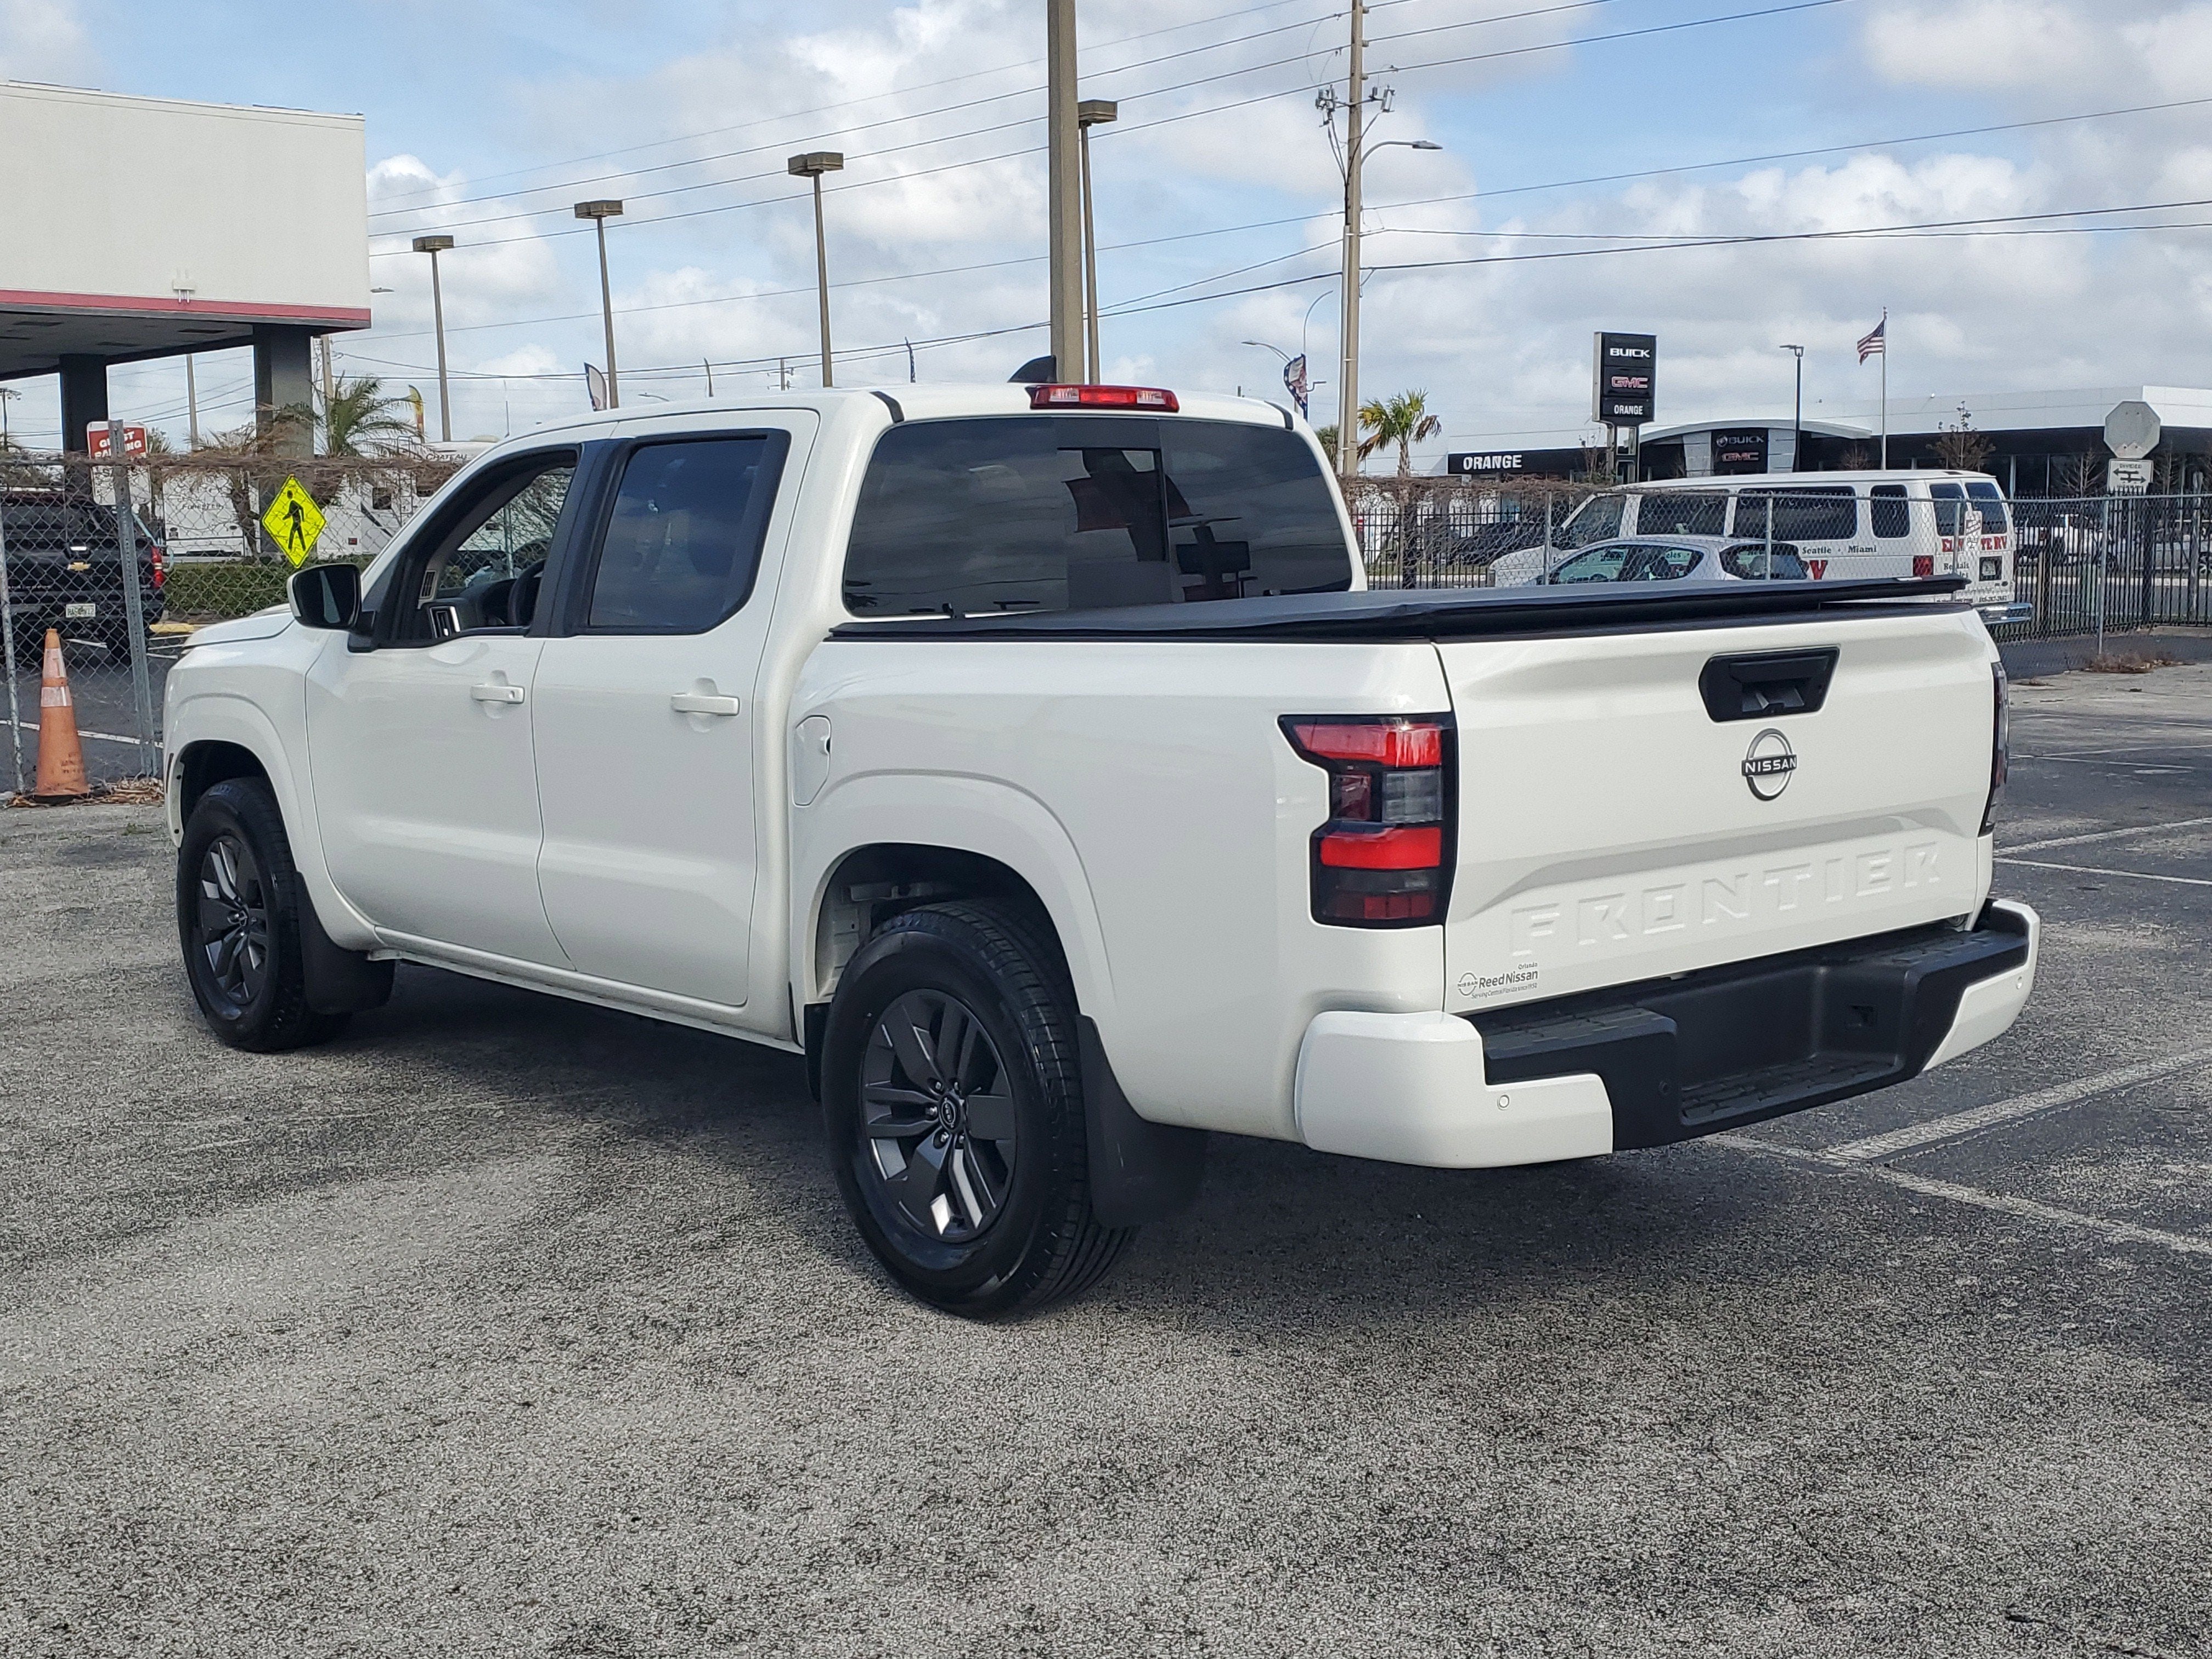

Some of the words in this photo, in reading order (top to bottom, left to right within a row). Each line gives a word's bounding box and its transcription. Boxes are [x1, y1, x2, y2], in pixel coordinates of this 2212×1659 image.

[1610, 348, 1650, 358] BUICK
[1611, 376, 1648, 388] GMC
[1614, 405, 1643, 415] ORANGE
[1729, 436, 1765, 444] BUICK
[1463, 454, 1522, 470] ORANGE
[1722, 452, 1759, 461] GMC
[1994, 535, 2007, 550] RV
[1848, 545, 1877, 553] Miami
[1745, 757, 1796, 774] NISSAN
[1511, 842, 1941, 956] FRONTIER
[1479, 973, 1505, 989] Reed
[1506, 970, 1538, 983] Nissan
